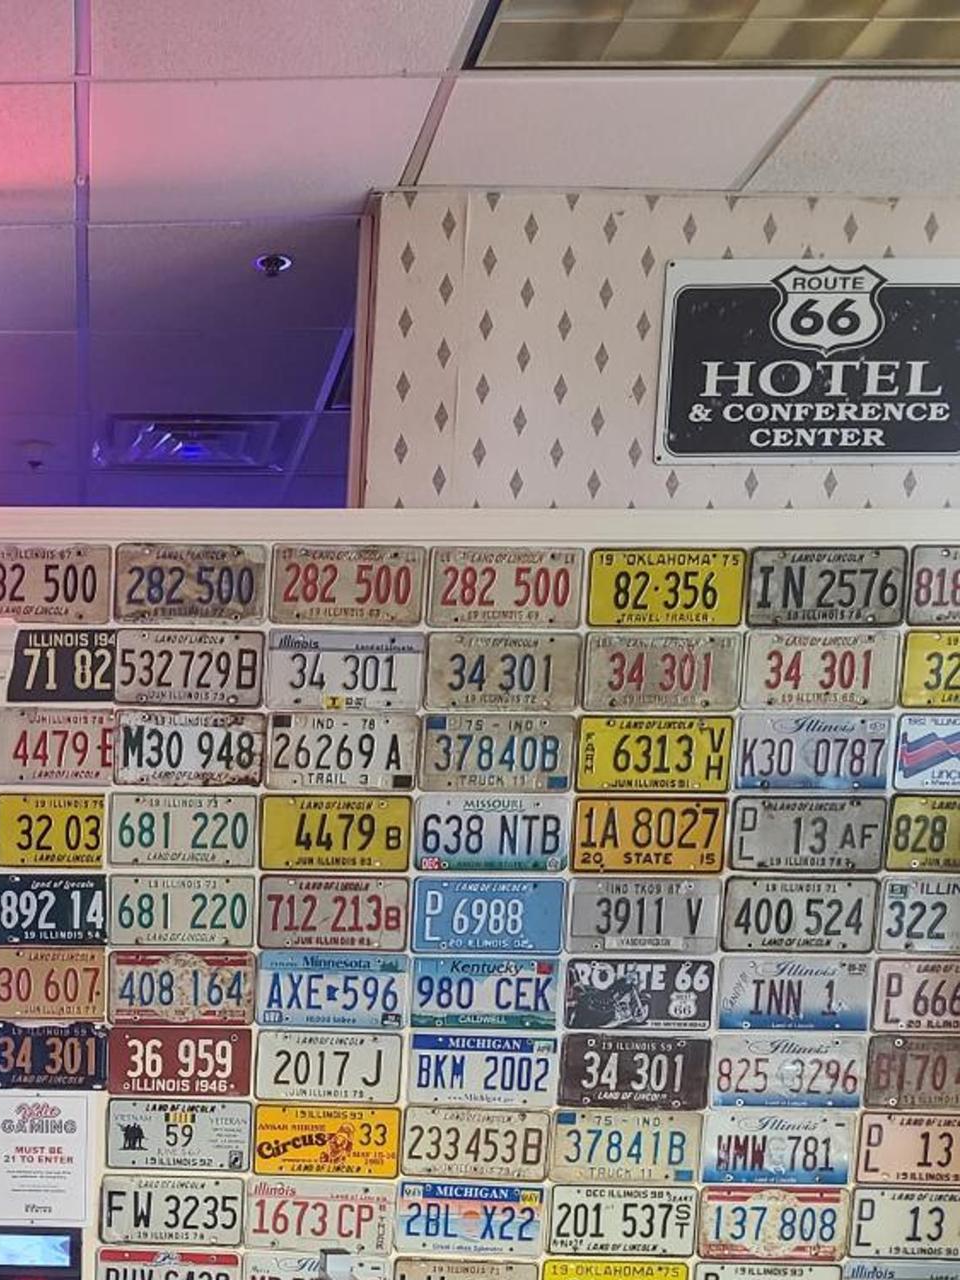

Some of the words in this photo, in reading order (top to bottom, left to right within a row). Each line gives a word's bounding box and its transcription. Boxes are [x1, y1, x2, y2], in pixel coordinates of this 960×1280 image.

[792, 276, 864, 290] ROUTE
[790, 299, 860, 336] 66
[699, 360, 942, 397] HOTEL
[689, 404, 712, 422] &
[722, 403, 950, 421] CONFERENCE
[750, 428, 885, 446] CENTER
[44, 564, 97, 603] 500
[441, 567, 496, 607] 282
[514, 566, 571, 607] 500
[29, 632, 88, 647] ILLINOIS
[279, 637, 319, 649] Illinois
[24, 649, 56, 689] 71
[74, 650, 112, 690] 82
[290, 653, 325, 690] 34
[344, 654, 397, 692] 301
[765, 650, 801, 689] 34
[820, 650, 871, 689] 301
[790, 718, 855, 733] Illinois
[124, 727, 182, 768] M30
[198, 728, 255, 768] 948
[613, 735, 693, 773] 6313
[119, 814, 170, 849] 681
[191, 813, 248, 850] 220
[296, 814, 375, 850] 4479
[581, 808, 618, 848] 1A
[633, 808, 720, 849] 8027
[793, 817, 828, 854] 13
[840, 823, 878, 848] AF
[624, 854, 672, 864] STATE
[0, 891, 57, 929] 892
[71, 891, 104, 927] 14
[453, 899, 523, 935] 6988
[735, 898, 793, 935] 400
[805, 899, 863, 935] 524
[302, 957, 371, 968] Minnesota
[451, 961, 523, 975] Kentucky
[44, 968, 98, 1001] 607
[269, 974, 327, 1009] AXE
[341, 976, 398, 1011] 596
[127, 1040, 164, 1077] 36
[178, 1039, 233, 1078] 959
[449, 1037, 521, 1050] MICHIGAN
[132, 1080, 191, 1092] ILLINOIS
[195, 1080, 227, 1092] 1946
[417, 1055, 465, 1089] BKM
[484, 1056, 549, 1091] 2002
[717, 1059, 769, 1093] 825
[790, 1059, 858, 1094] 3296
[1, 1121, 77, 1134] GAMING
[360, 1124, 387, 1145] 33
[4, 1155, 18, 1164] 21
[22, 1155, 35, 1164] TO
[38, 1156, 73, 1165] ENTER
[15, 1146, 44, 1155] MUST
[49, 1147, 63, 1155] BE
[436, 1186, 509, 1198] MICHIGAN
[164, 1195, 238, 1231] 3235
[252, 1200, 327, 1235] 1673
[337, 1204, 373, 1239] CP
[556, 1204, 604, 1238] 201
[622, 1204, 671, 1238] 537
[576, 1266, 654, 1276] OKLAHOMA
